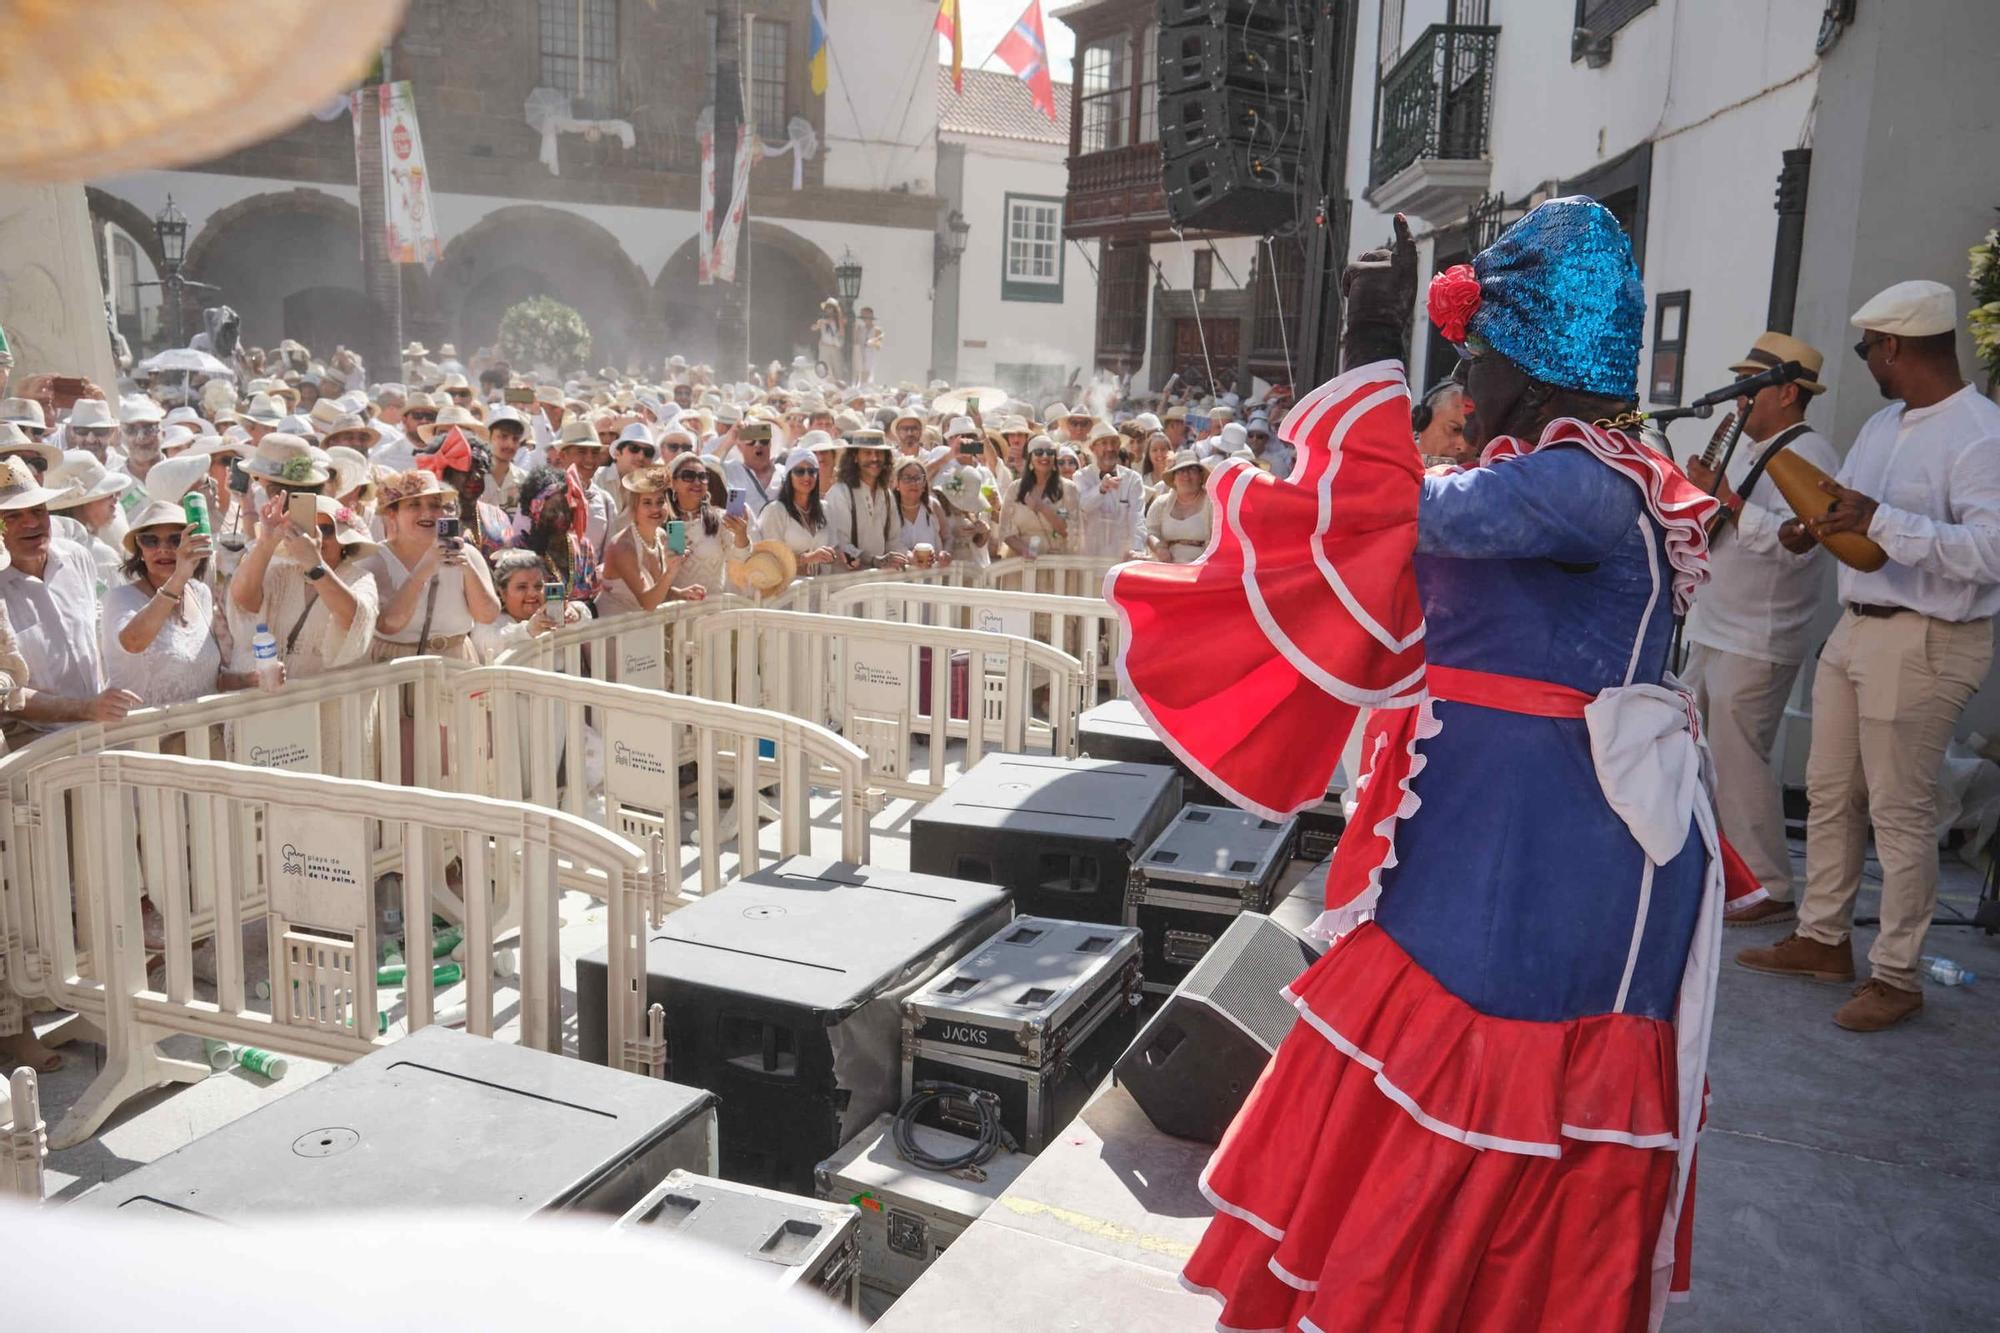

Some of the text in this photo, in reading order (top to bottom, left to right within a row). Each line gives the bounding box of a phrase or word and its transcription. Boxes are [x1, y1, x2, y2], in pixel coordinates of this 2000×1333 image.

[271, 752, 290, 761] santa
[307, 855, 340, 865] playa de
[308, 864, 351, 876] santa cruz
[308, 871, 356, 885] de la palma
[942, 1025, 988, 1045] JACKS
